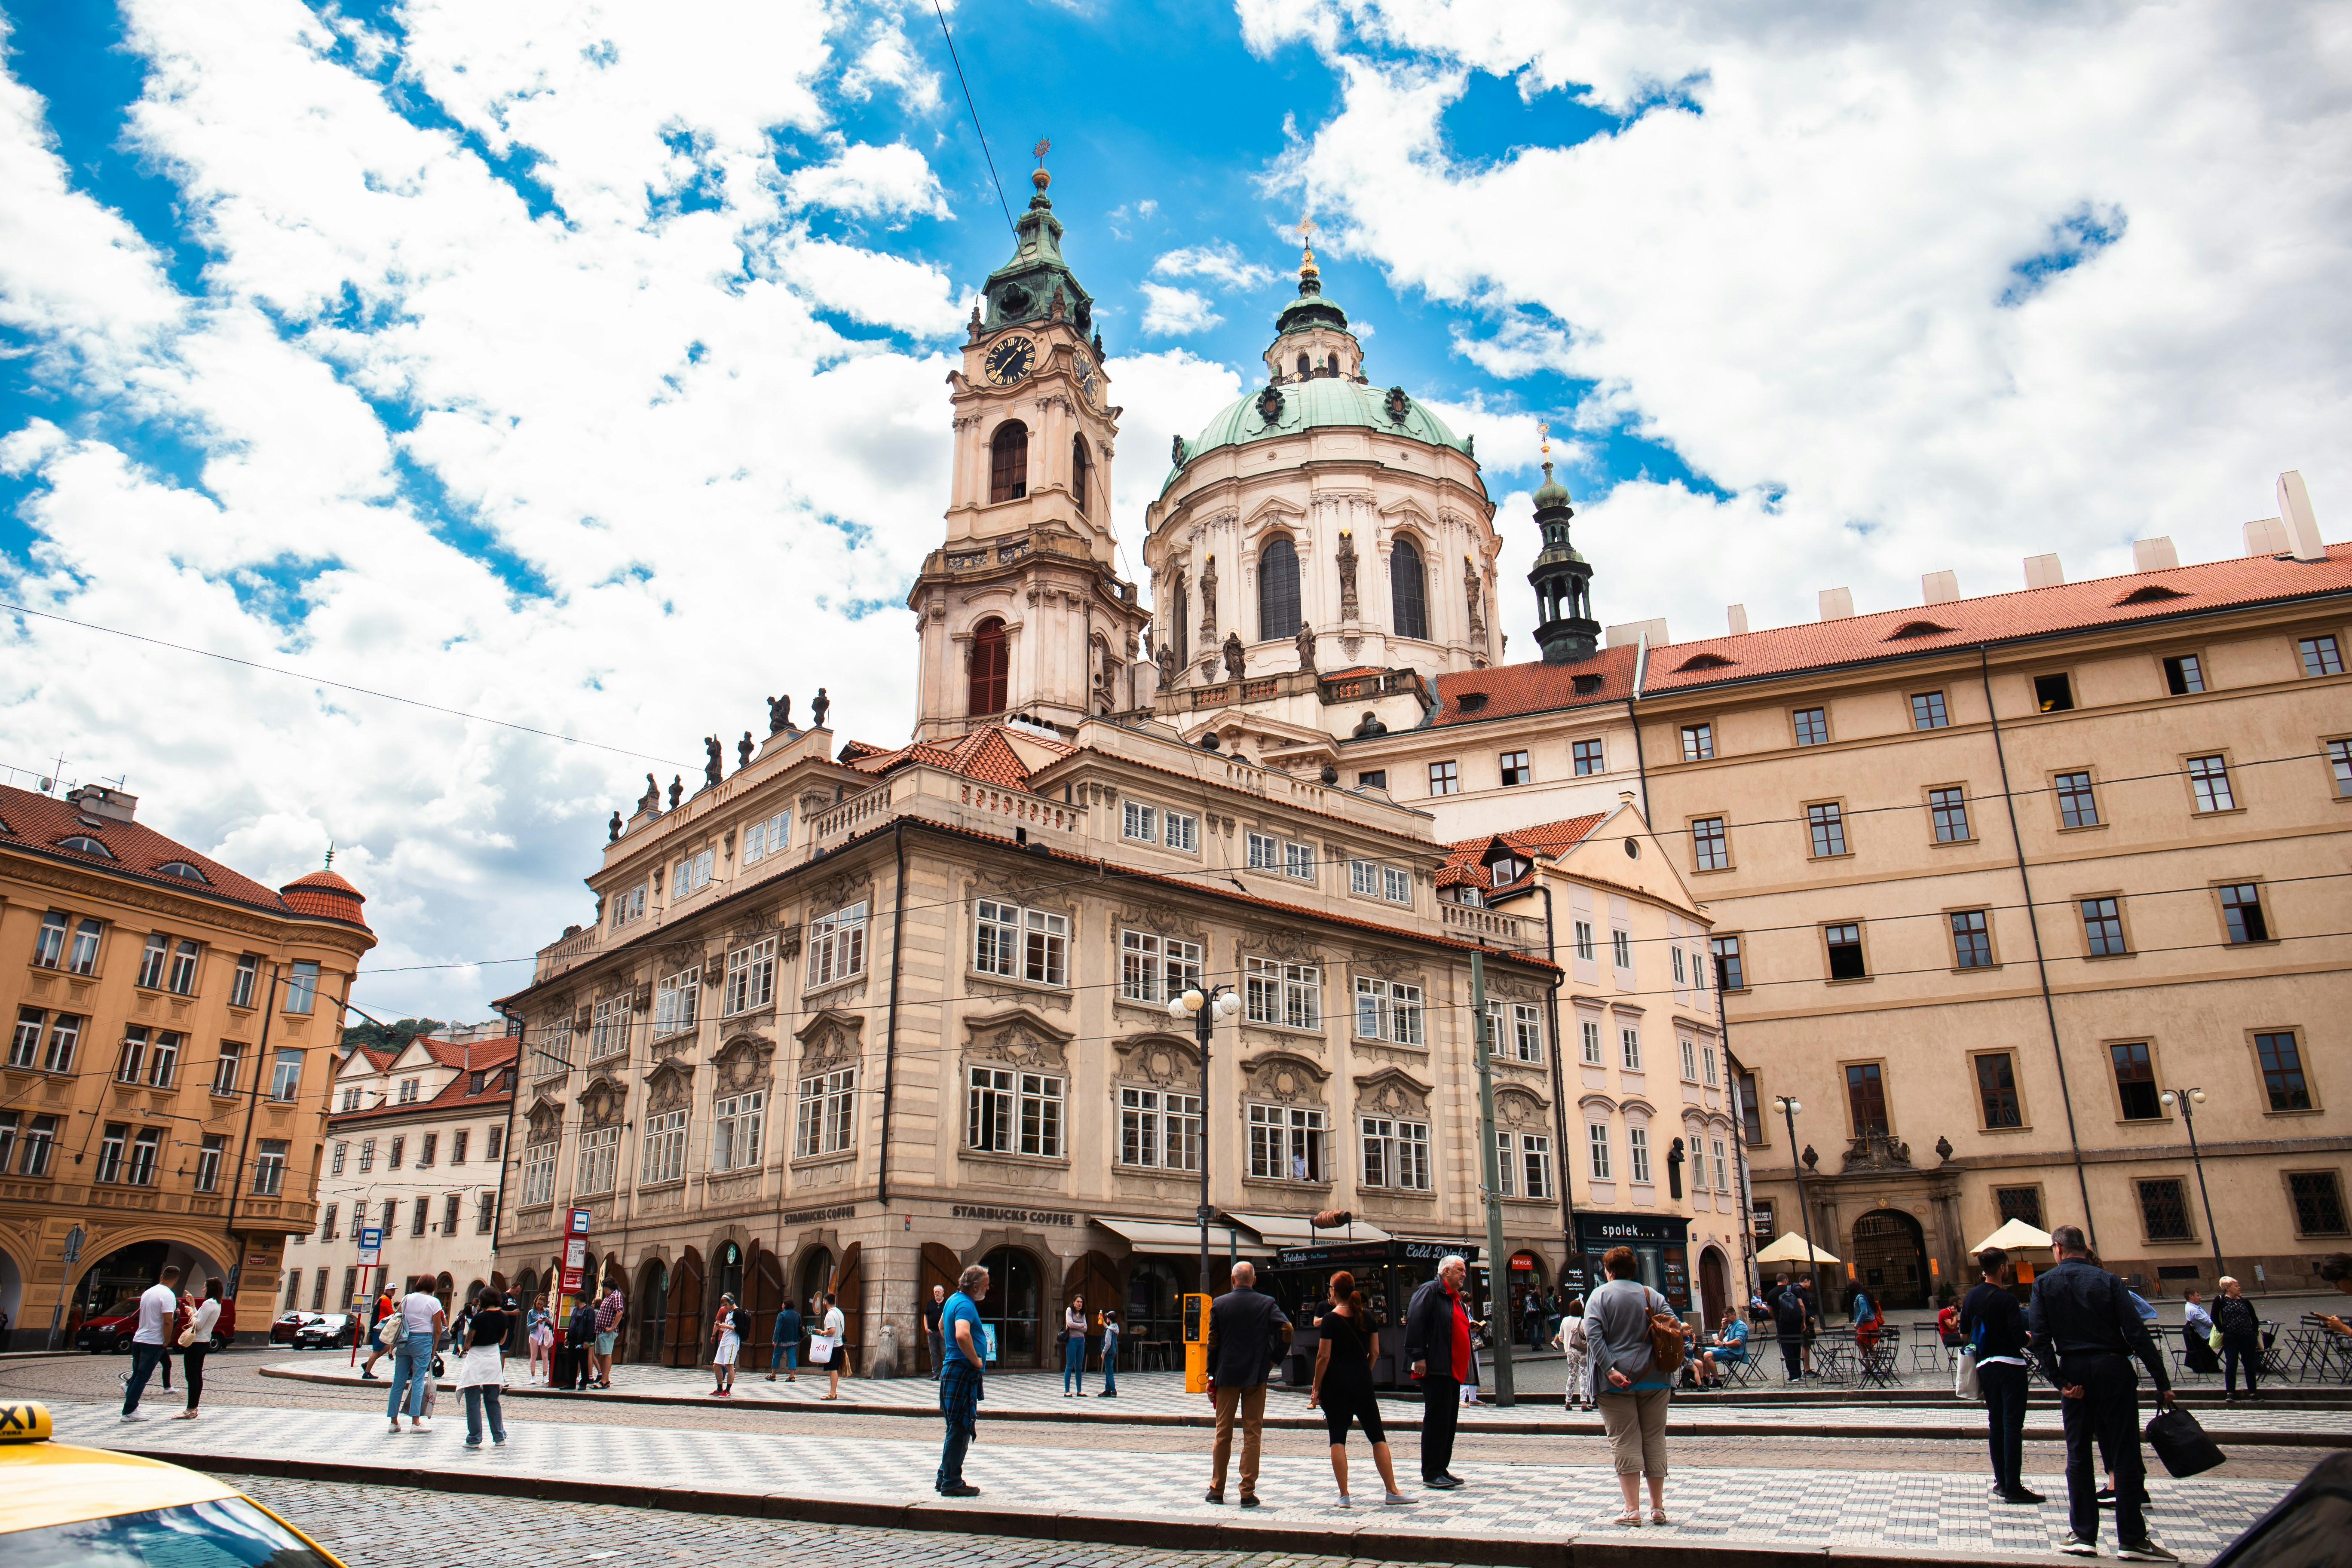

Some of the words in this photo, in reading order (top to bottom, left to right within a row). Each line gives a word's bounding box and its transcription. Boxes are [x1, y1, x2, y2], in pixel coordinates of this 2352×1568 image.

[996, 343, 1005, 352] XI
[1024, 343, 1032, 351] II
[1007, 376, 1013, 384] VI
[784, 1209, 826, 1225] STARBUCKS
[827, 1206, 855, 1219] COFFEE
[952, 1205, 1027, 1221] STARBUCKS
[1029, 1212, 1074, 1225] COFFEE
[1406, 1244, 1431, 1258] Cold
